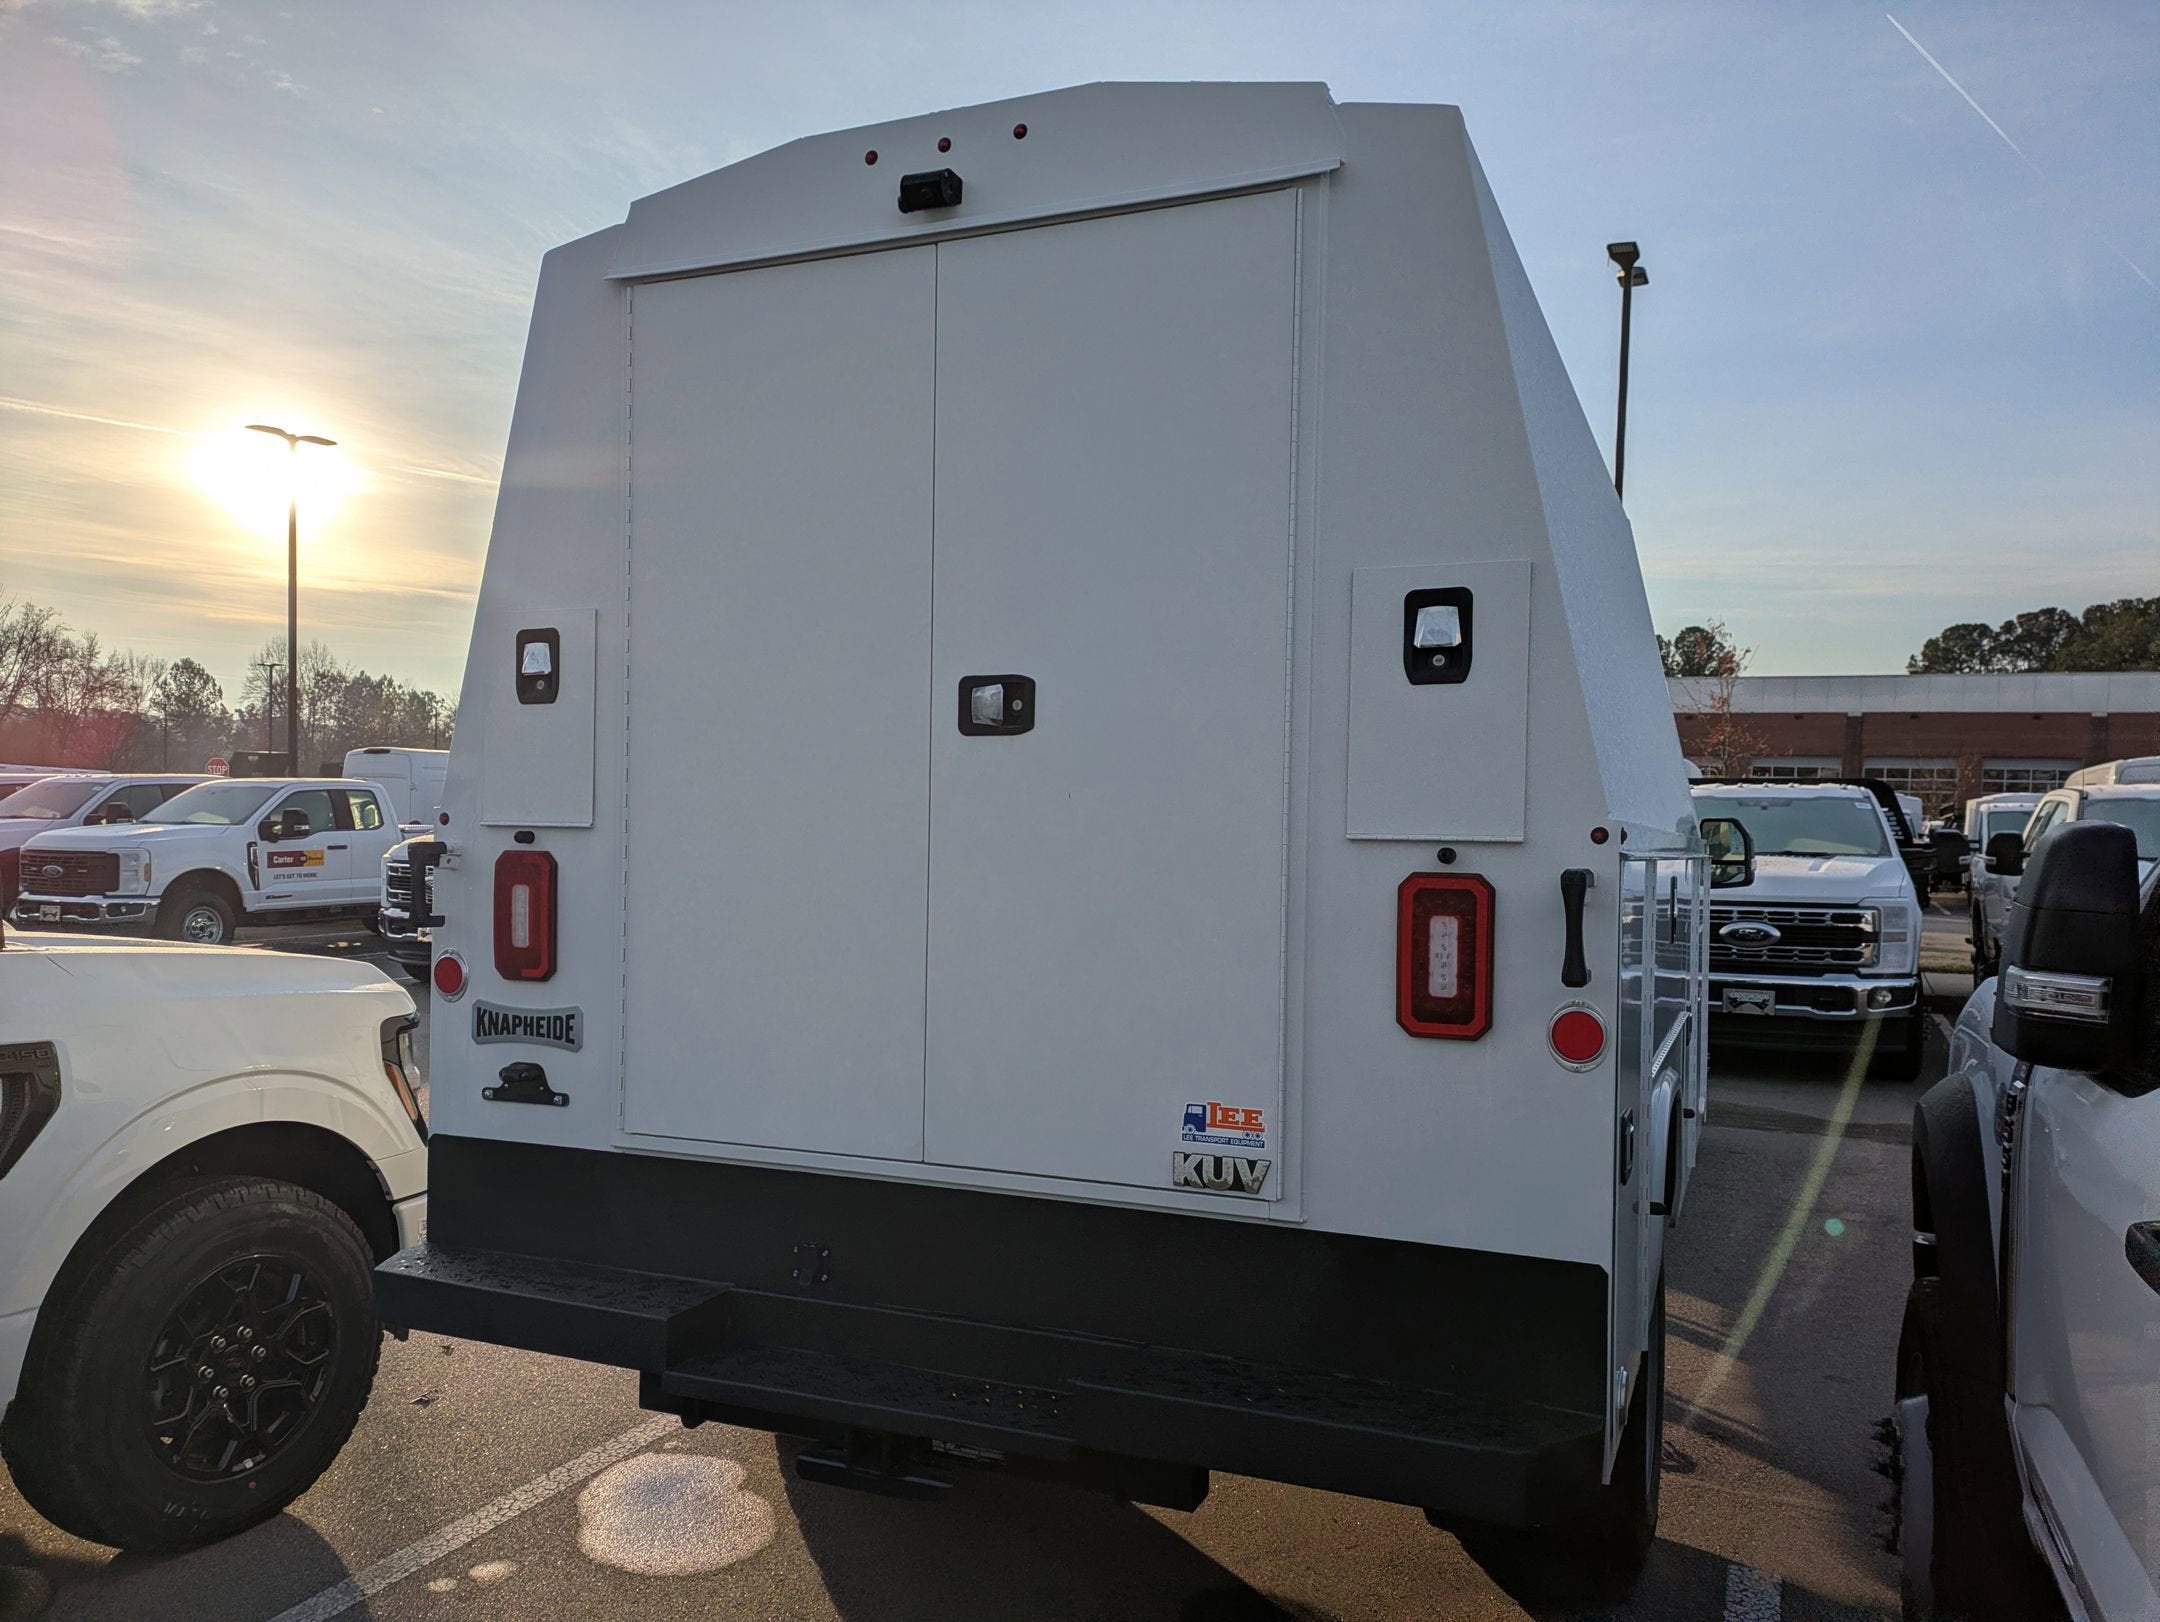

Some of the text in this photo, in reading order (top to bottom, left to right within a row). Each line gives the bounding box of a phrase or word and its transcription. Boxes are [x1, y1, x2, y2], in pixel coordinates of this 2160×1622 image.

[208, 765, 228, 775] STOP
[273, 856, 294, 864] Carter
[476, 1006, 576, 1045] KNAPHEIDE
[1206, 1102, 1264, 1131] LEE
[1195, 1135, 1228, 1144] TRANSPORT
[1230, 1138, 1264, 1147] EQUIPMENT
[1173, 1151, 1271, 1194] KUV
